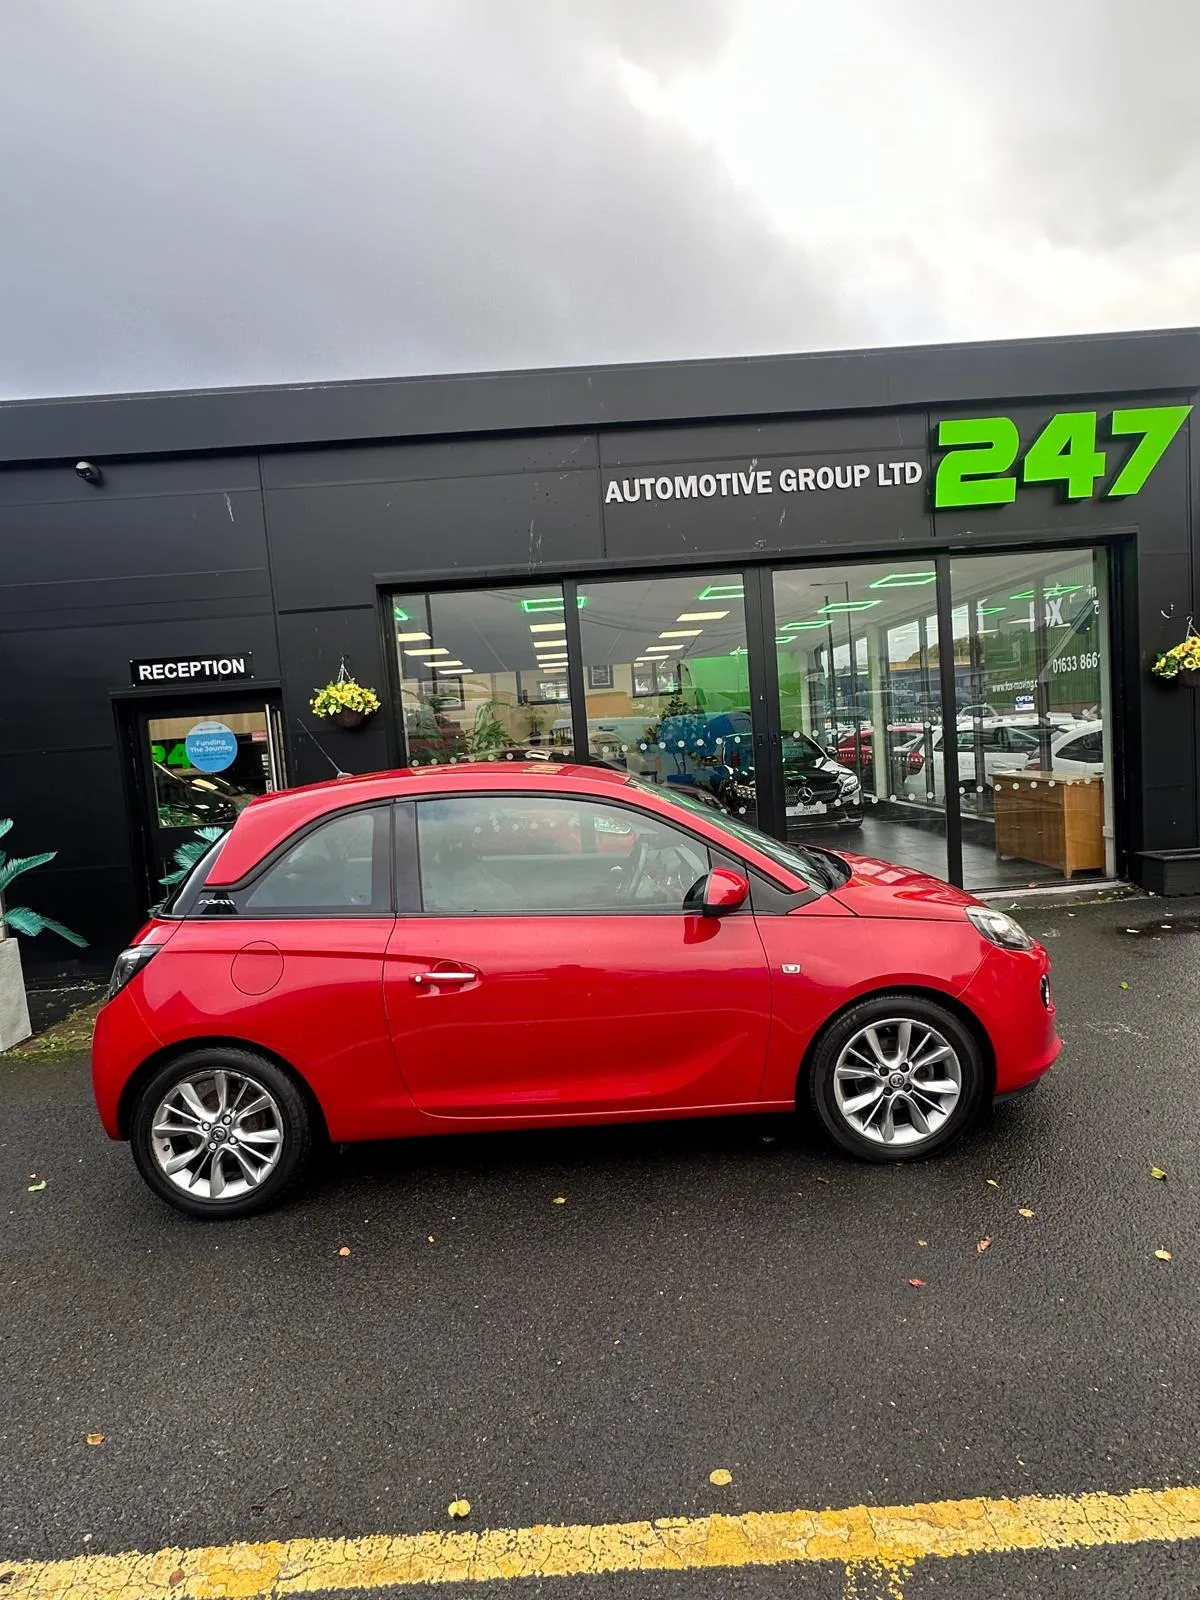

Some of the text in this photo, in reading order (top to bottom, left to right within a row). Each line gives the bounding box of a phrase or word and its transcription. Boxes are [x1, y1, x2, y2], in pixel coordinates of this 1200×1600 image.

[935, 405, 1194, 507] 247
[605, 461, 923, 504] AUTOMOTIVE GROUP LTD
[138, 658, 245, 680] RECEPTION
[1052, 655, 1078, 674] 01633
[195, 739, 226, 747] Funding
[204, 744, 233, 752] Journey
